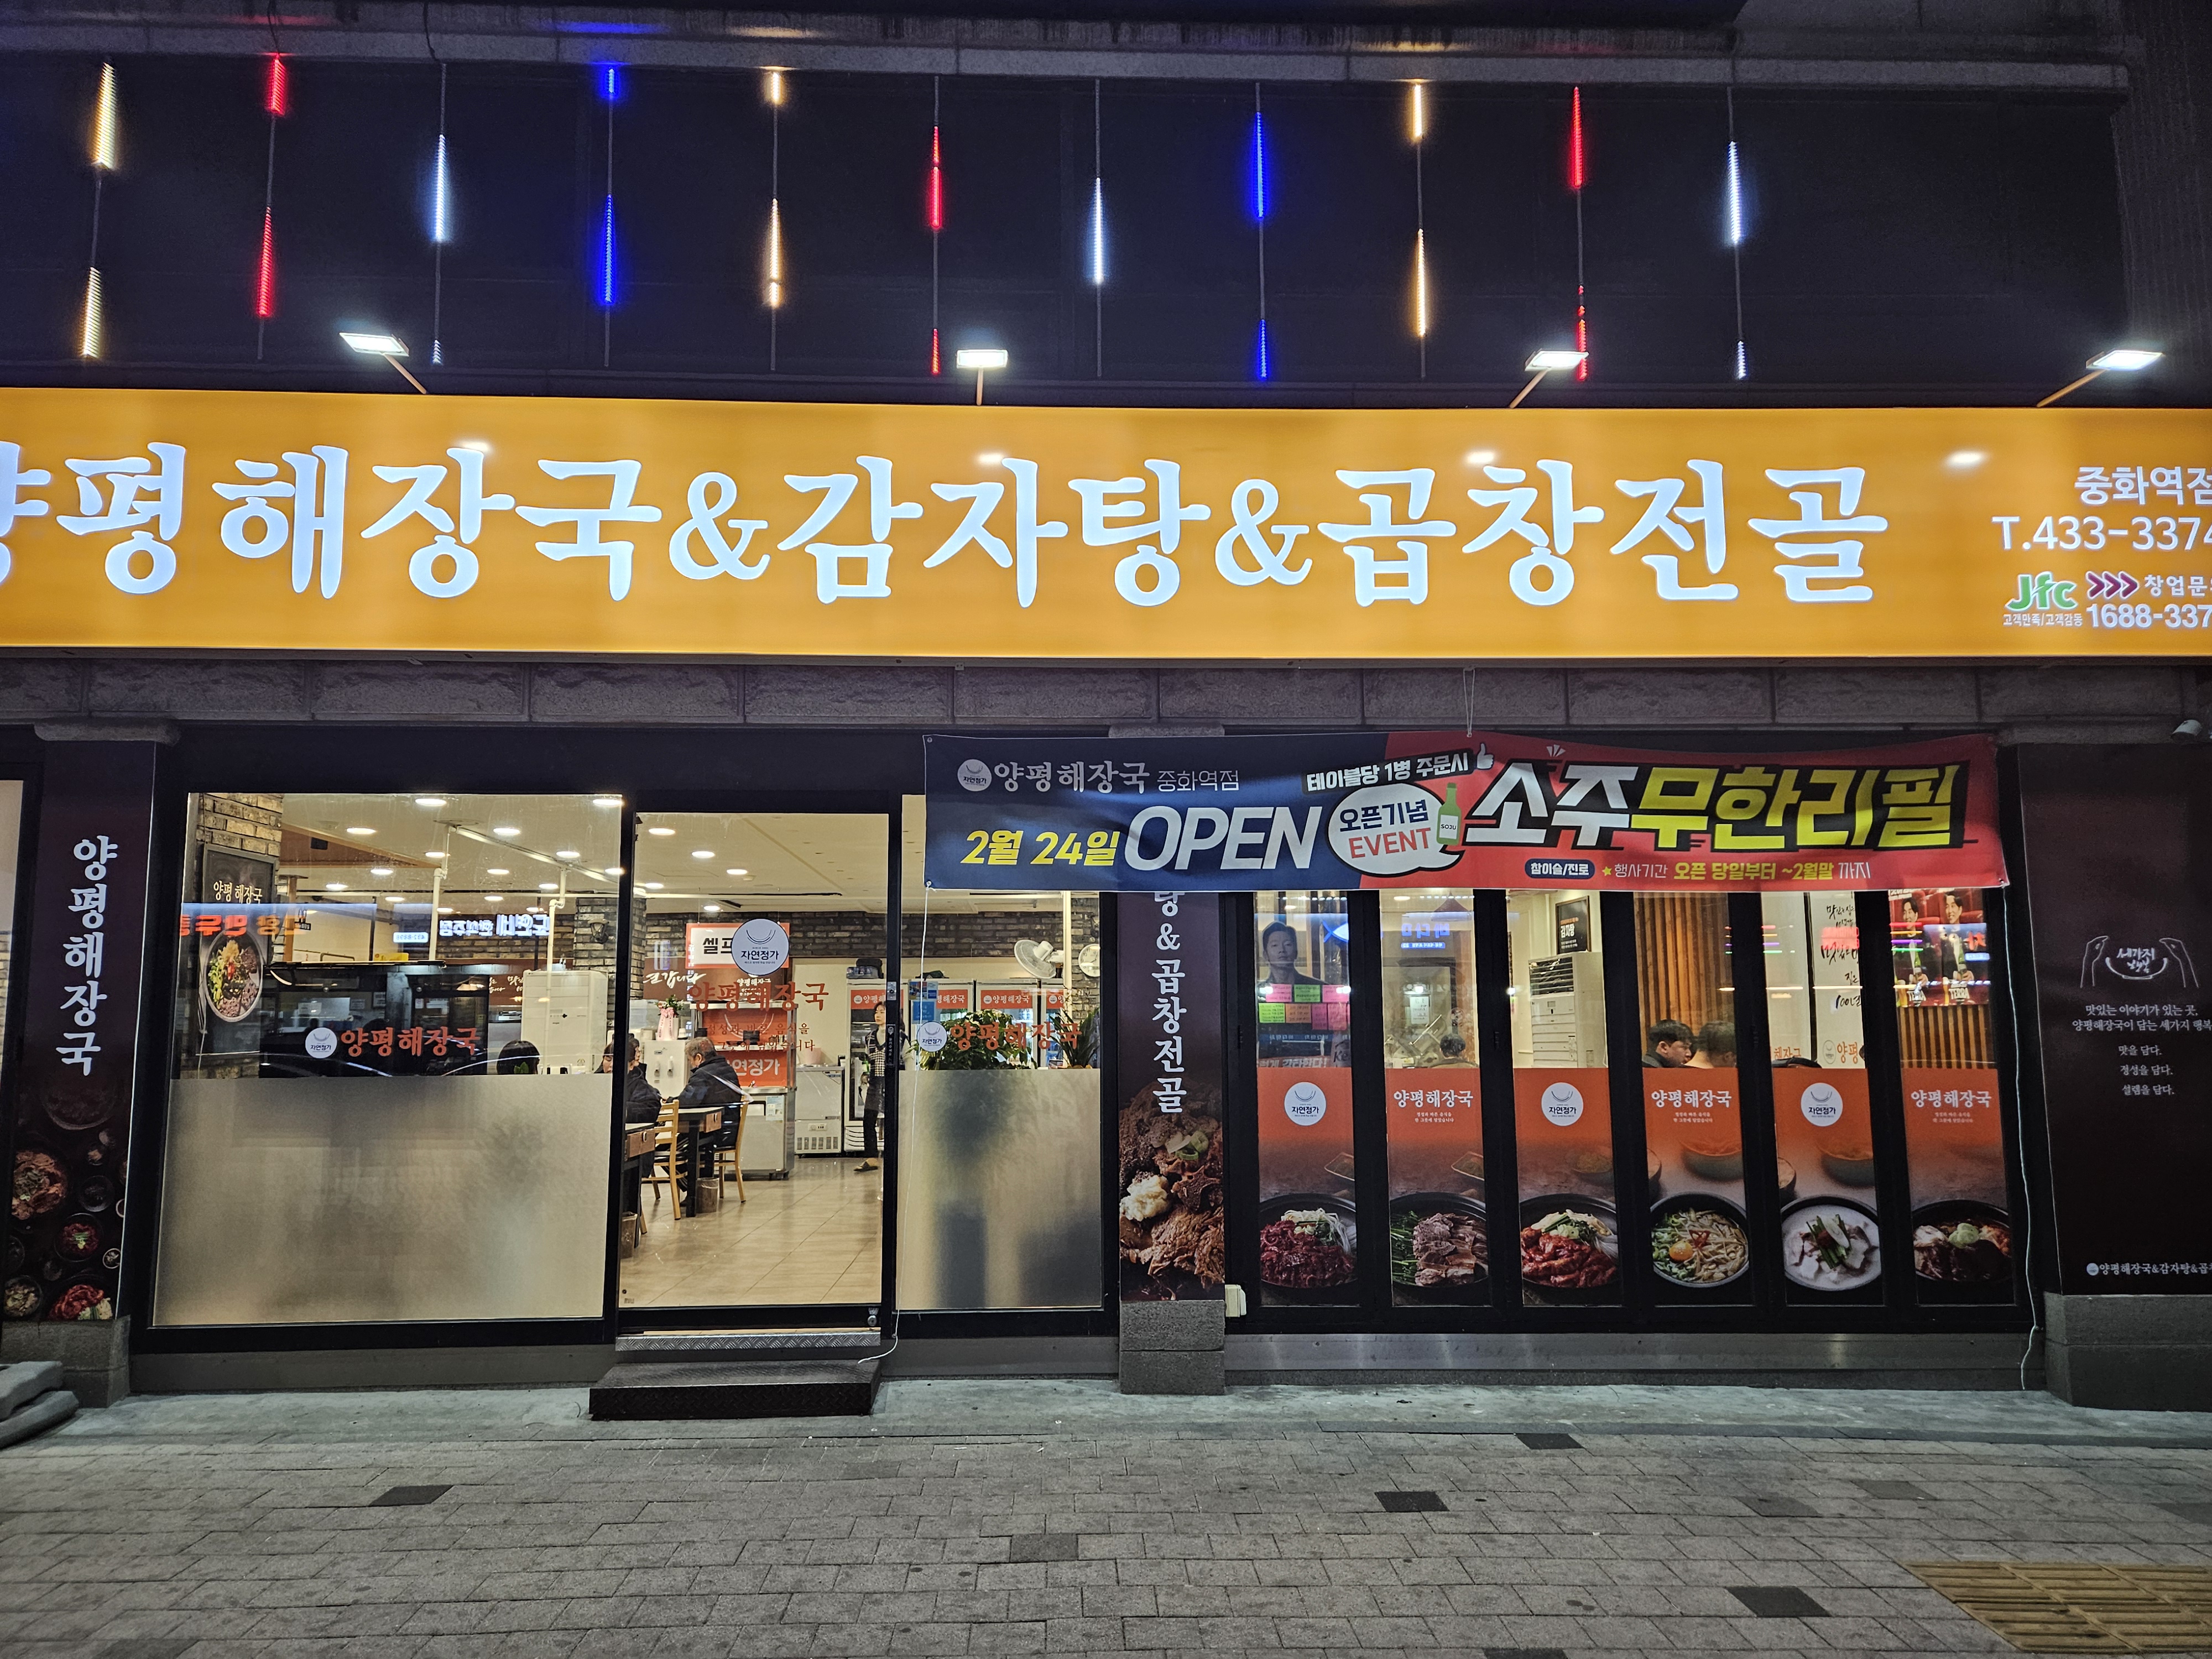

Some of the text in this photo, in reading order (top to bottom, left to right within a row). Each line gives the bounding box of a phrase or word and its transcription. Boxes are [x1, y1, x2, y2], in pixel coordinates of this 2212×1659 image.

[2075, 466, 2212, 505] 중화역점
[2145, 575, 2212, 597] 창업문
[2003, 613, 2083, 627] 고객만족/고객감동
[994, 760, 1239, 794] 양평해장국 중화역점
[1306, 752, 1469, 791] 테이블당 1병 주문시
[1339, 799, 1429, 832] 오픈기념
[960, 806, 1322, 870] 2월 24일 OPEN
[1348, 827, 1431, 859] EVENT
[1530, 862, 1590, 877] 참이슬/진로
[1614, 863, 1668, 879] 행사기간
[1673, 862, 1706, 880] 오픈
[1711, 862, 1776, 880] 당일부터
[1838, 862, 1871, 879] 까지
[55, 834, 119, 1076] 양평해장국
[740, 950, 779, 961] 자연정가
[688, 981, 829, 1011] 양평해장국
[2085, 1004, 2198, 1016] 맛있는 이야기가 있는 곳,
[2072, 1019, 2133, 1031] 양평해장국이
[2136, 1019, 2157, 1031] 담는
[2159, 1019, 2190, 1031] 세가지
[341, 1027, 480, 1057] 양평해장국
[951, 1022, 1082, 1050] 양평해장국
[2119, 1045, 2162, 1056] 맛을 담다.
[2120, 1065, 2173, 1076] 정성을 담다.
[1393, 1089, 1474, 1108] 양평해장국
[1651, 1089, 1732, 1108] 양평해장국
[1911, 1089, 1992, 1108] 양평해장국
[2153, 1084, 2174, 1095] 담다.
[1291, 1106, 1319, 1114] 자연정가
[1808, 1107, 1836, 1115] 자연정가
